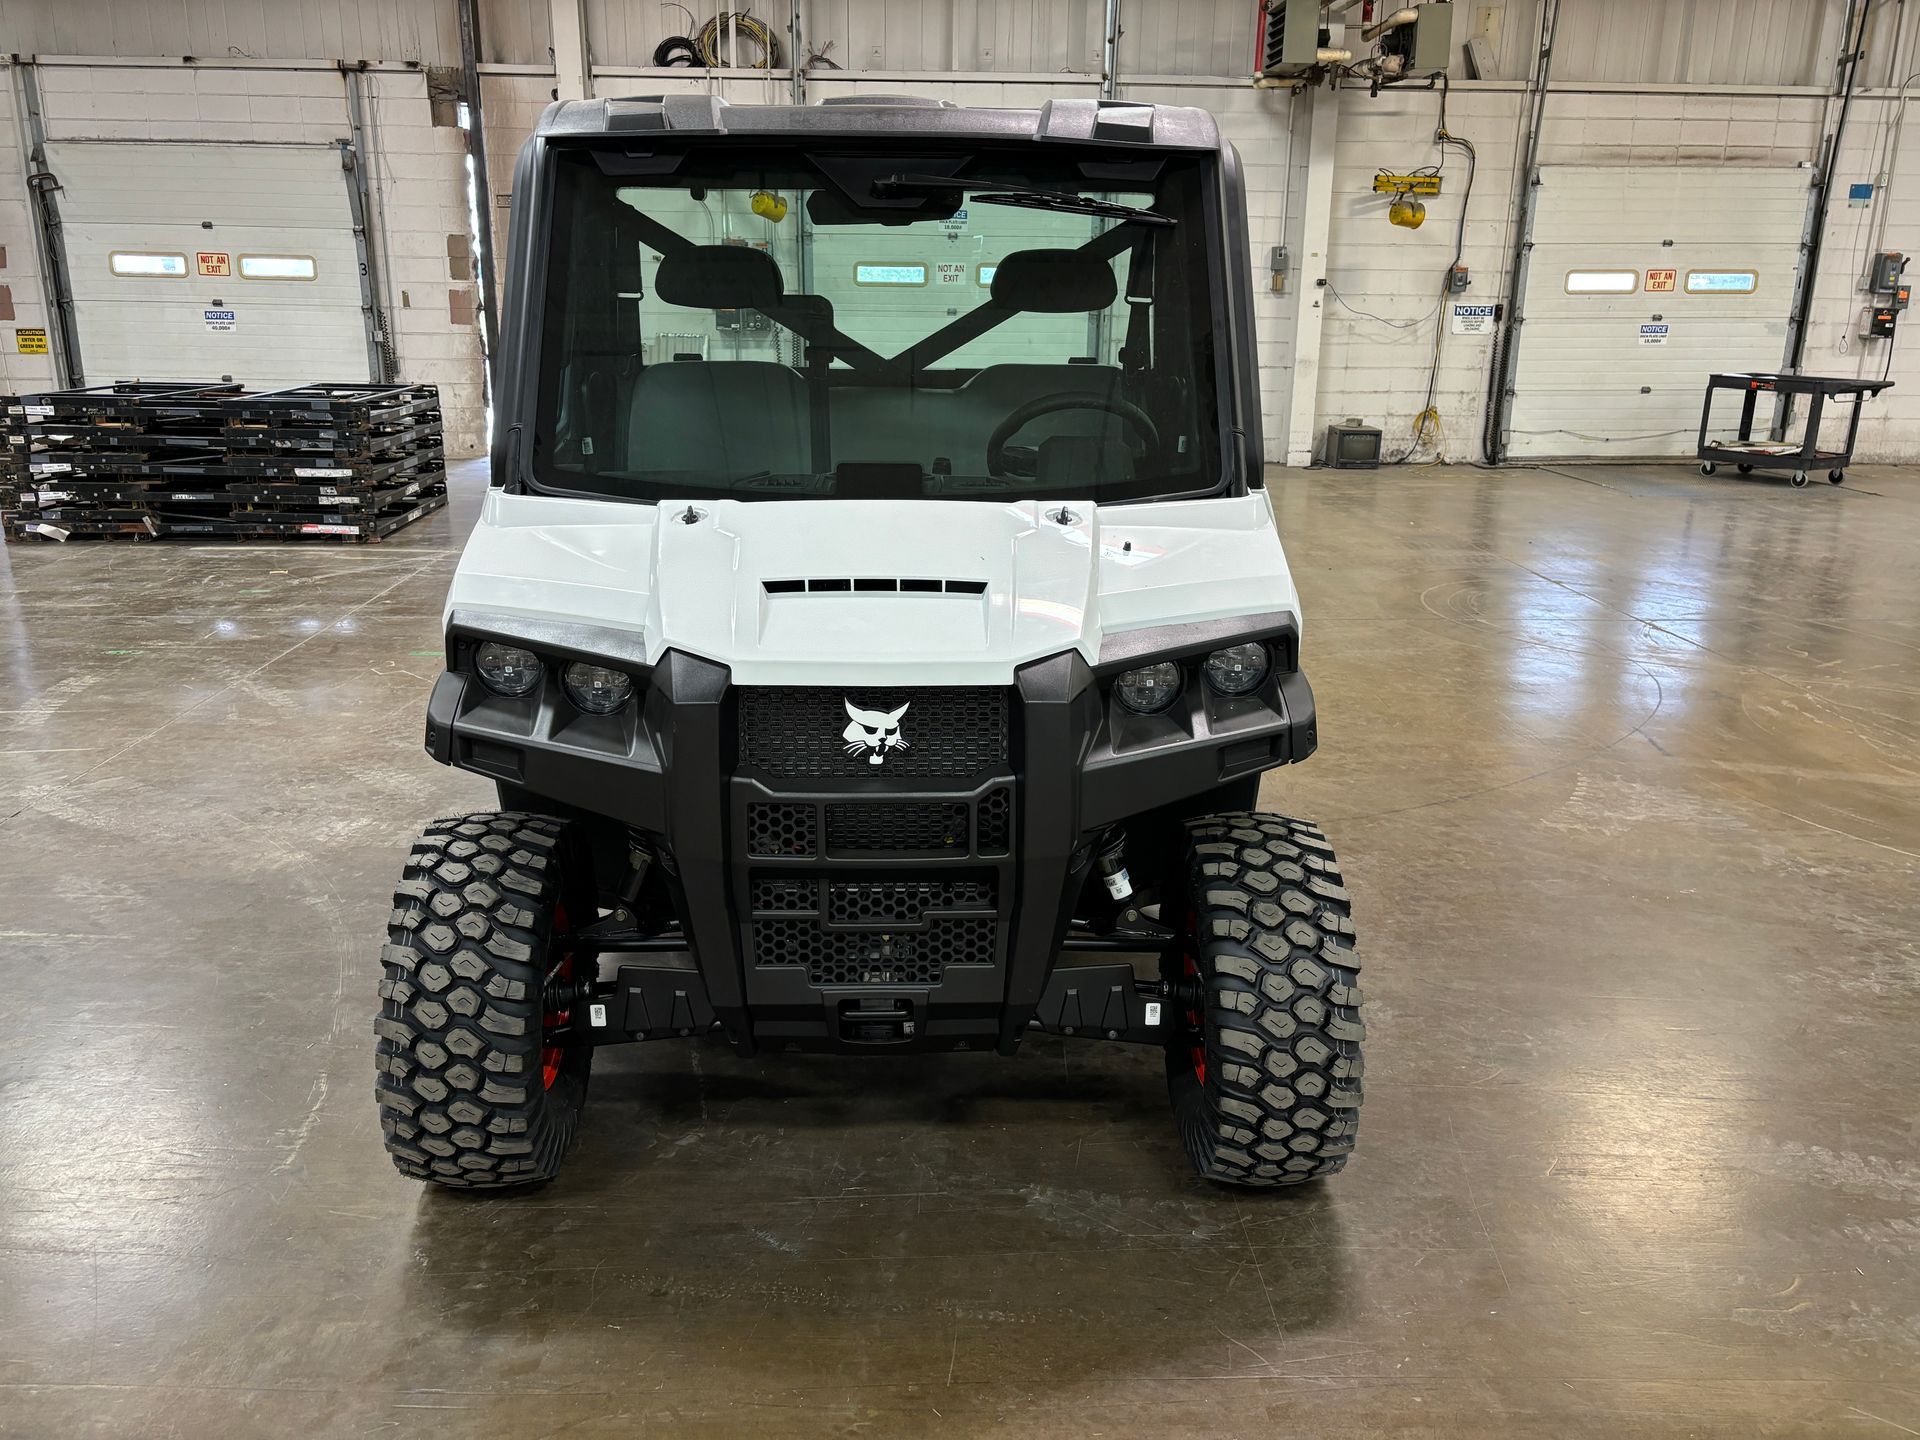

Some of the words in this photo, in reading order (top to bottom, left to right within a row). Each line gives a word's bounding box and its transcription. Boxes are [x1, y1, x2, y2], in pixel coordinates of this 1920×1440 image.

[200, 256, 214, 264] NOT
[217, 256, 226, 264] AN
[206, 265, 222, 274] EXIT
[1456, 307, 1492, 315] NOTICE
